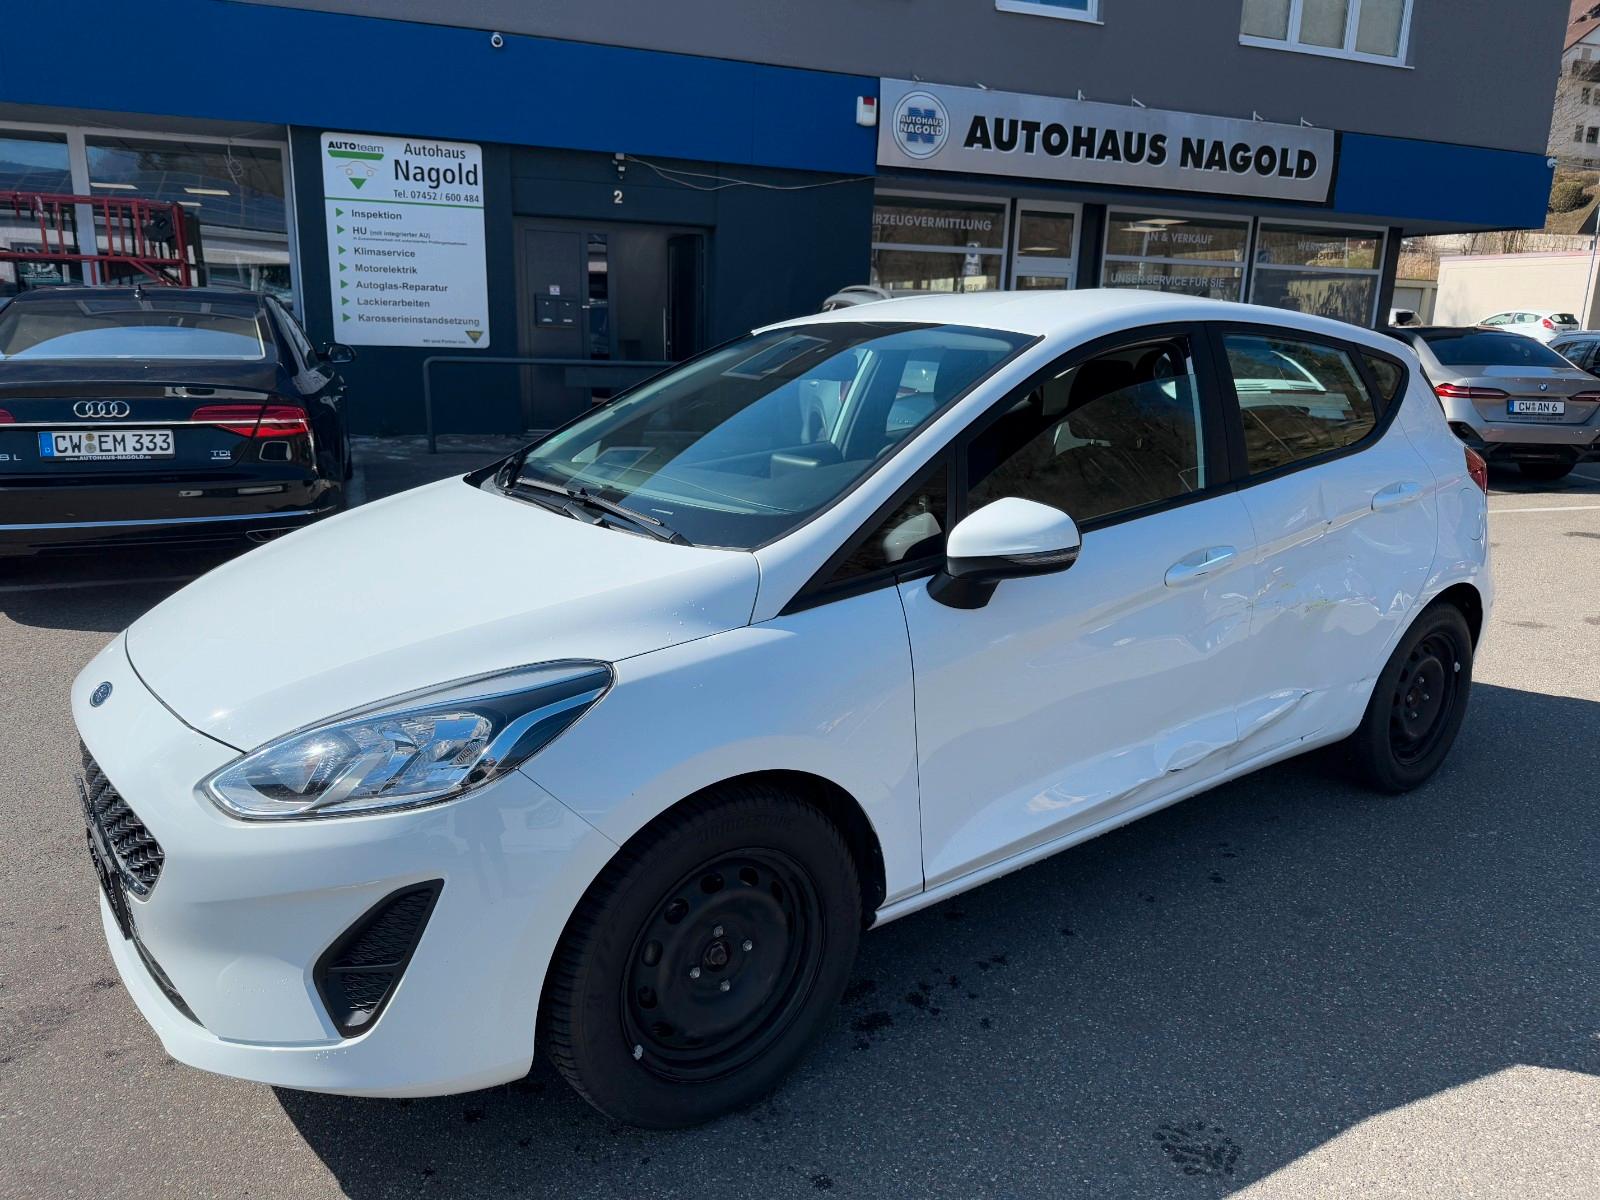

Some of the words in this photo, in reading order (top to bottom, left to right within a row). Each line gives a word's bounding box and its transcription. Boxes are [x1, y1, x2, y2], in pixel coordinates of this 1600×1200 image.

[900, 114, 943, 126] AUTOHAUS
[900, 122, 943, 136] NAGOLD
[328, 141, 384, 153] AUTOteam
[404, 143, 466, 159] Autohaus
[964, 115, 1167, 166] AUTOHAUS
[1179, 136, 1318, 180] NAGOLD
[394, 159, 478, 189] Nagold
[393, 190, 408, 199] Tel.
[410, 190, 437, 201] 07452
[445, 192, 461, 202] 600
[464, 194, 479, 203] 484
[613, 190, 623, 204] 2
[351, 209, 402, 220] Inspektion
[352, 226, 367, 235] HU
[1171, 233, 1214, 245] VERKAUF
[354, 247, 416, 258] Klimaservice
[355, 264, 418, 274] Motorelektrik
[356, 281, 448, 293] Autoglas-Reparatur
[1146, 274, 1187, 286] SERVICE
[1210, 278, 1225, 288] SIE
[357, 297, 430, 308] Lackierarbeiten
[358, 314, 480, 327] Karosserieinstandsetzung
[1519, 402, 1531, 411] CW
[1537, 402, 1549, 411] AN
[1551, 403, 1557, 412] 6
[54, 435, 82, 453] CW
[98, 434, 126, 452] EM
[132, 433, 171, 451] 333
